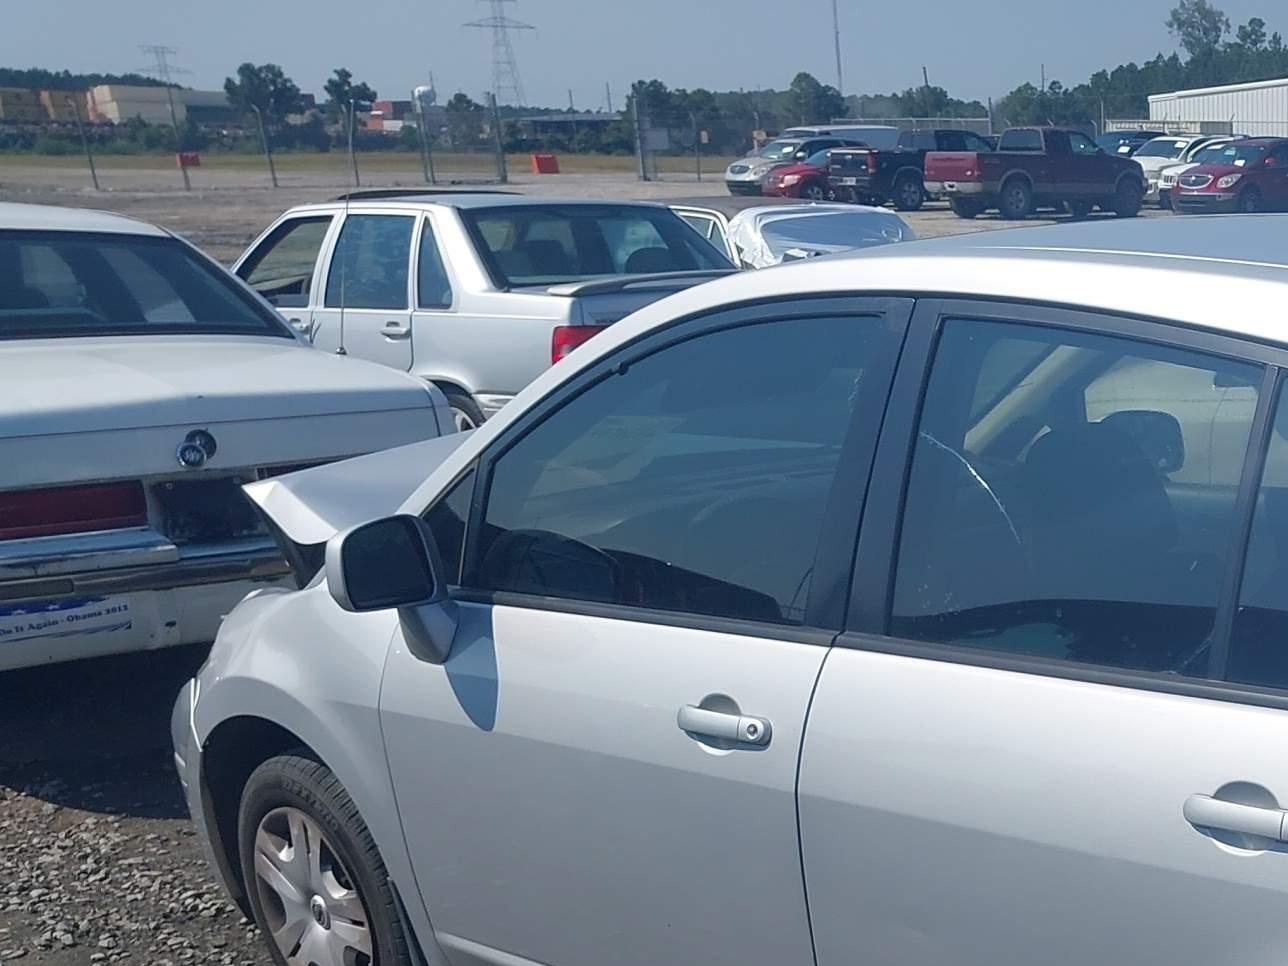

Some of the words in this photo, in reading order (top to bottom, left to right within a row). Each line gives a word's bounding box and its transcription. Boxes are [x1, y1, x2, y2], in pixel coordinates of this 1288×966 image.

[15, 625, 24, 633] It
[27, 619, 59, 631] Again
[66, 610, 103, 623] Obama
[104, 604, 129, 616] 2012
